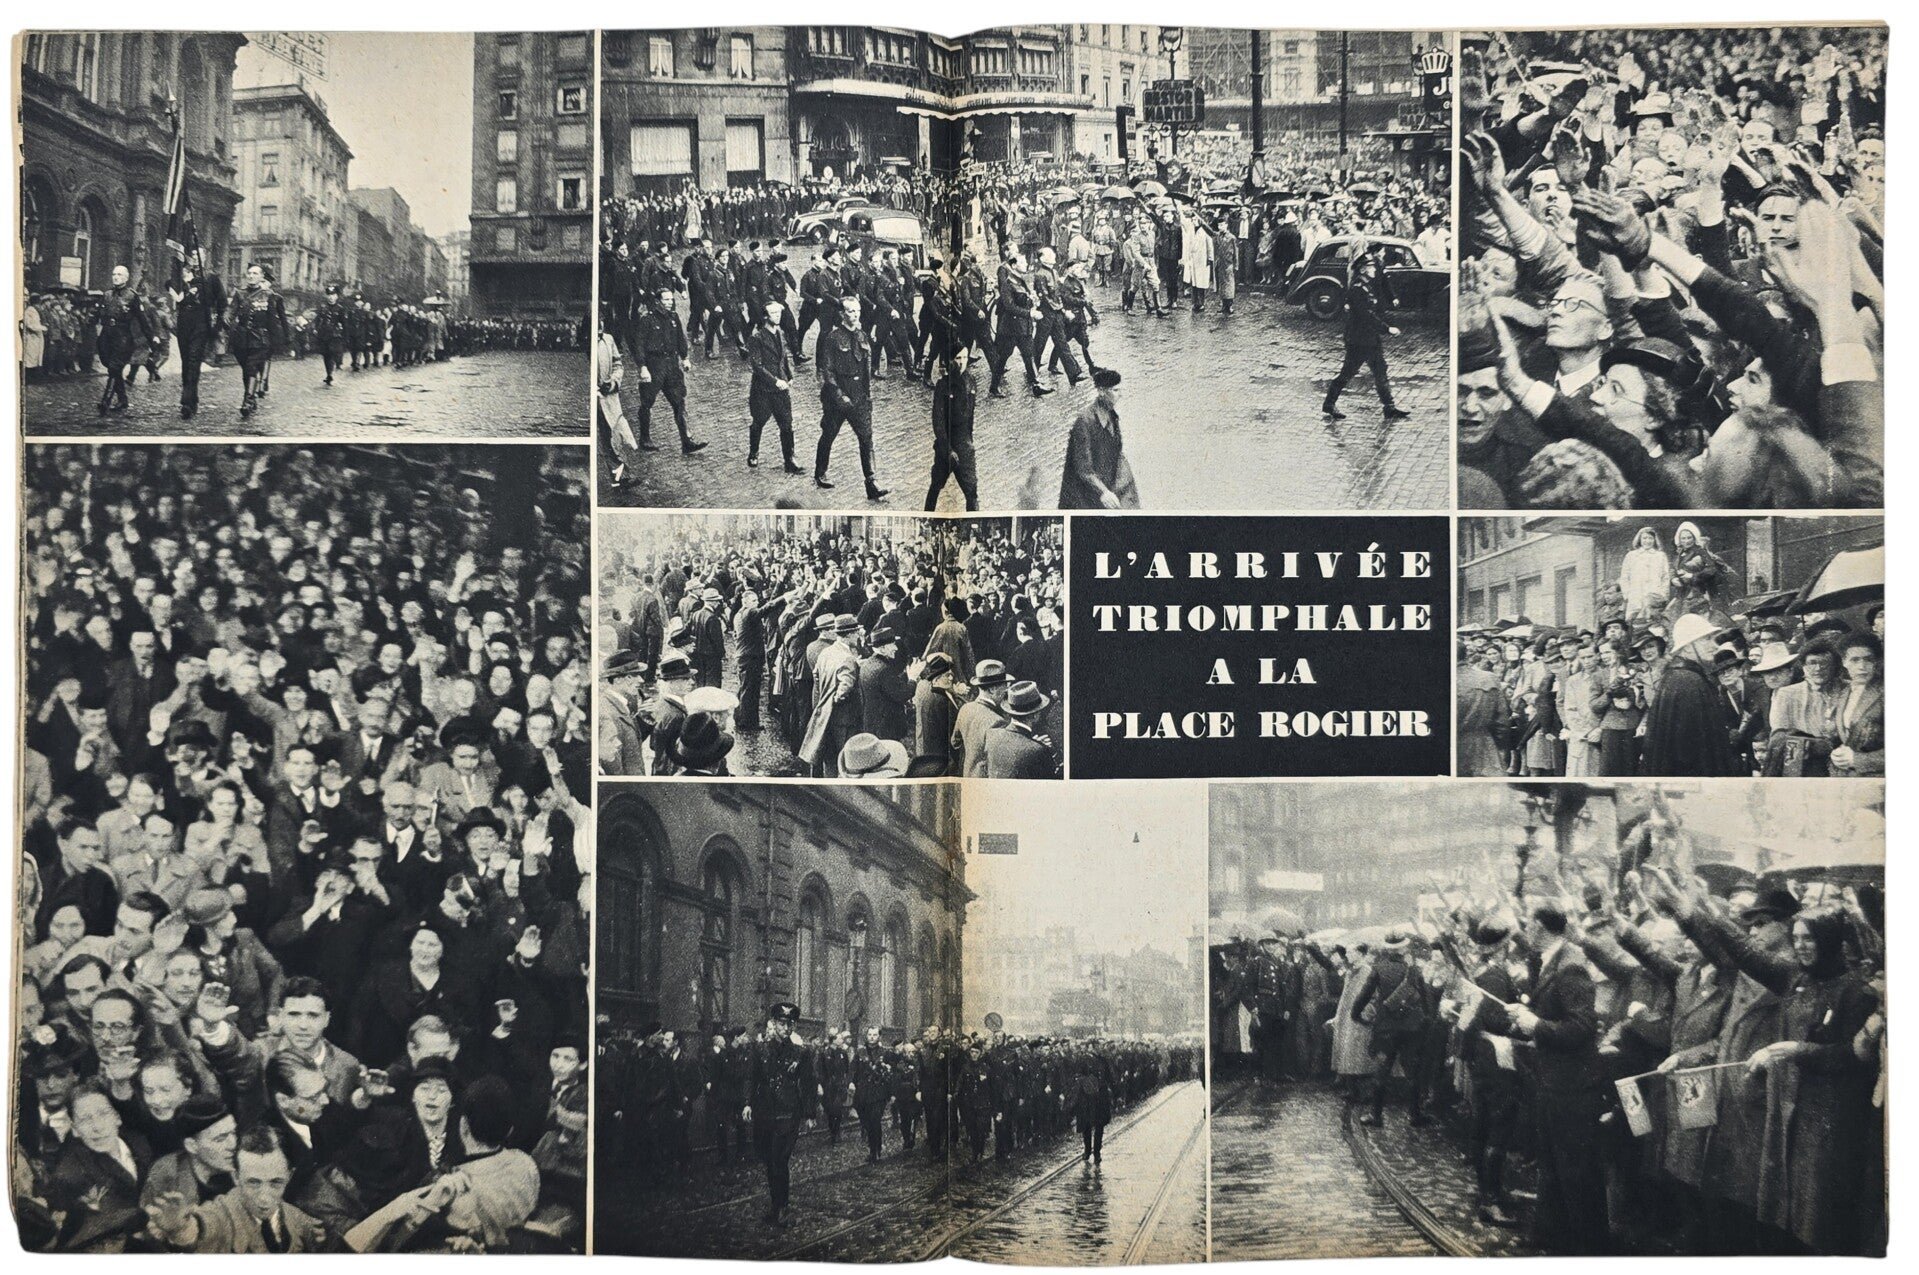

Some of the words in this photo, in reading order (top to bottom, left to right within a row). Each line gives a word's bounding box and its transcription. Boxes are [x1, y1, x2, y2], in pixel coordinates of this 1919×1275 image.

[1092, 604, 1431, 632] TRIOMPHALE
[1205, 658, 1235, 685] A
[1258, 657, 1317, 685] LA
[1091, 711, 1235, 739] PLACE
[1258, 710, 1431, 738] ROGIER
